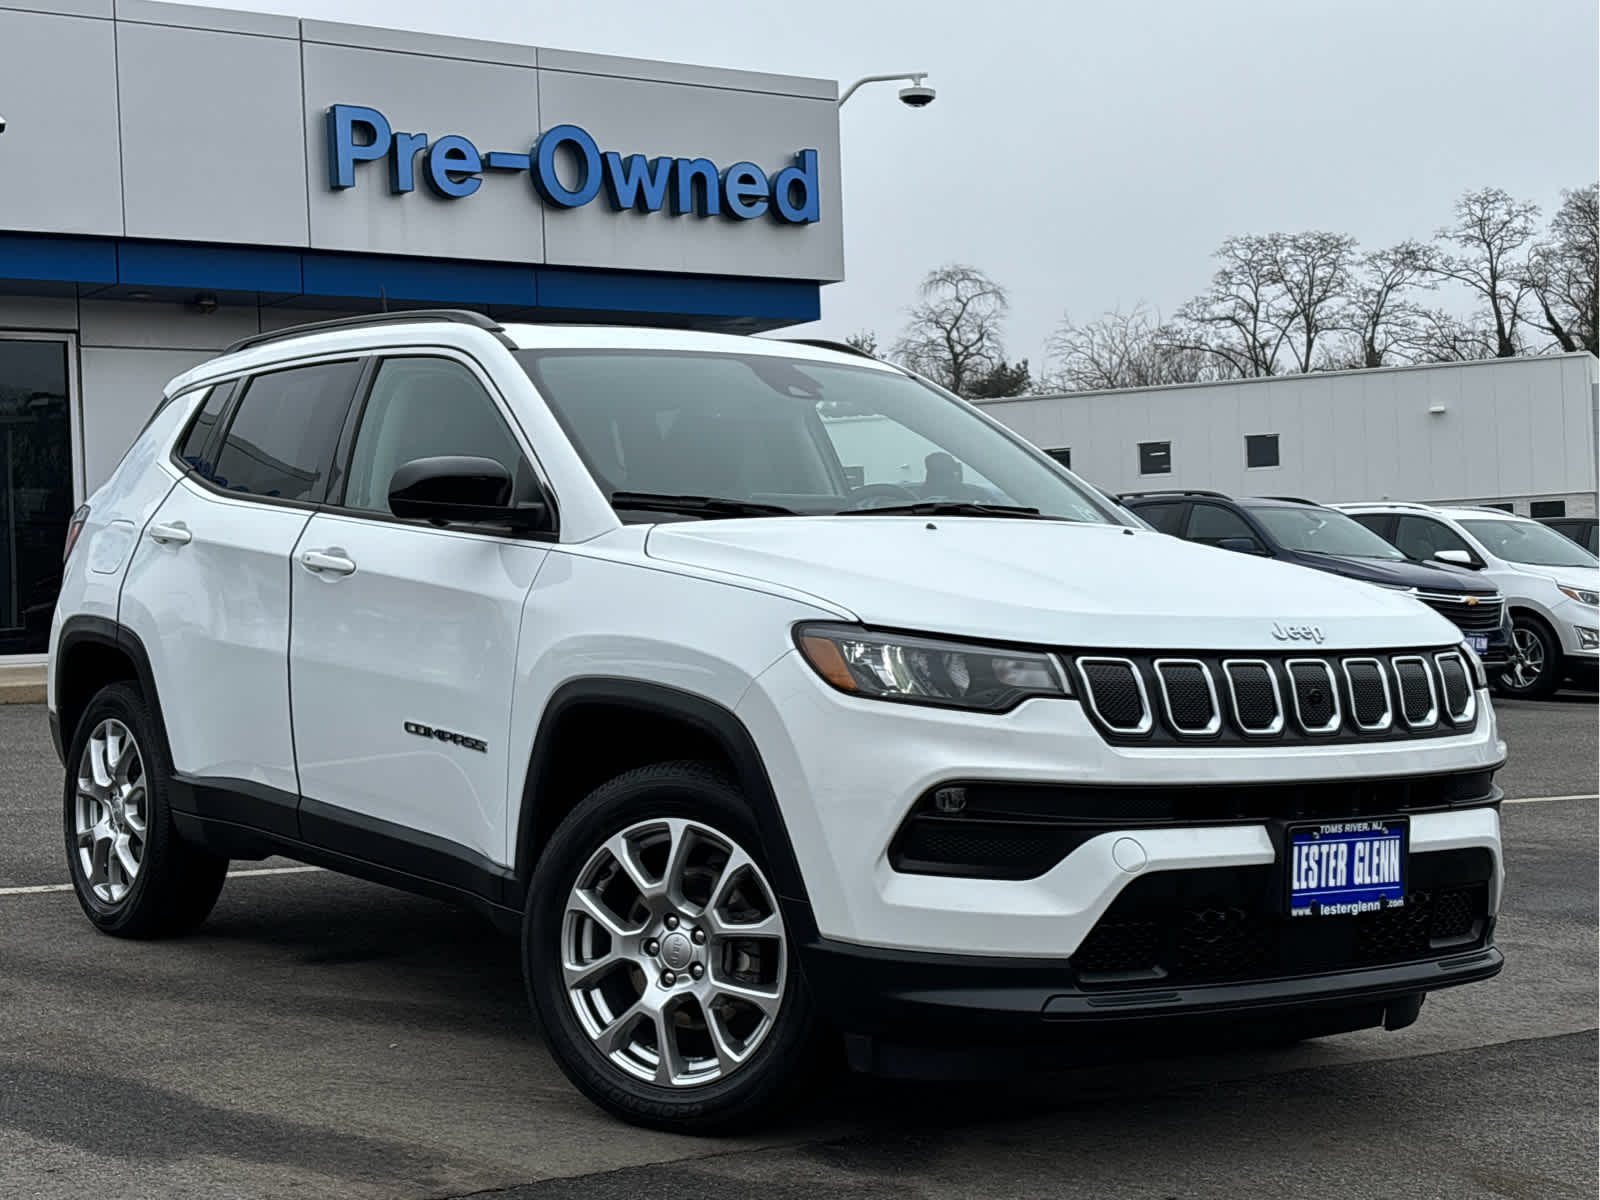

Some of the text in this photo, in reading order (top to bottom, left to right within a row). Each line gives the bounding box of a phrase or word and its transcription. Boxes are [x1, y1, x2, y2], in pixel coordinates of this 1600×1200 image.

[326, 103, 821, 226] Pre-Owned
[1271, 620, 1325, 645] Jeep
[404, 721, 488, 754] COMPASS
[1320, 823, 1343, 835] TOMS
[1292, 839, 1400, 890] LESTER GLENN
[1320, 901, 1381, 916] lesterglenn
